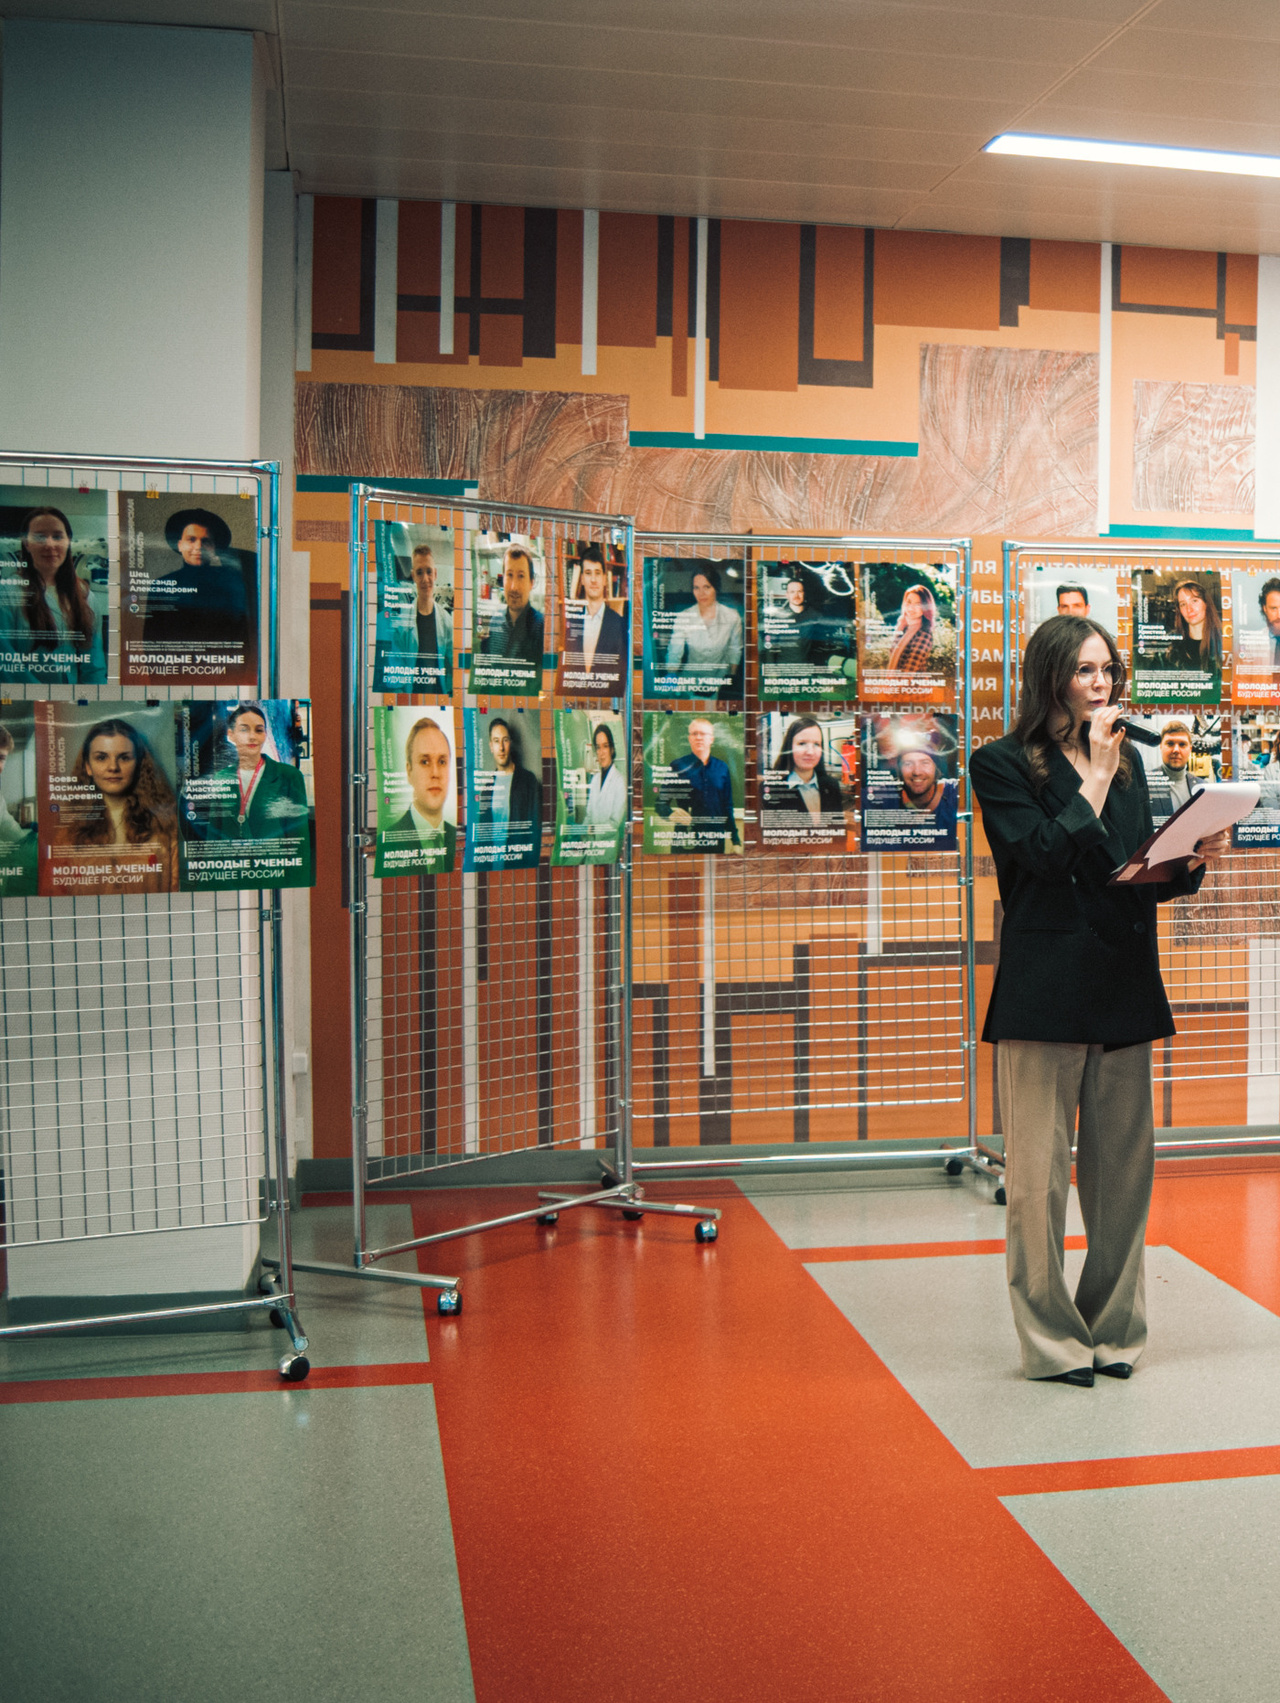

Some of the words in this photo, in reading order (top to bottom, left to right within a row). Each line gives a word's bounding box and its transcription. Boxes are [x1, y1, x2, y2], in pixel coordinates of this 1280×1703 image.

[129, 570, 149, 581] Шец
[129, 578, 177, 588] Александр
[129, 586, 198, 595] Александрович
[43, 654, 91, 665] УЧЕНЫЕ
[129, 654, 193, 667] МОЛОДЫЕ
[196, 655, 245, 666] УЧЕНЫЕ
[28, 664, 71, 675] РОССИИ
[129, 665, 179, 677] БУДУЩЕЕ
[182, 666, 226, 676] РОССИИ
[383, 666, 419, 676] МОЛОДЫЕ
[421, 667, 446, 677] УЧЕНЫЕ
[383, 676, 413, 684] БУДУЩЕЕ
[413, 677, 437, 685] РОССИИ
[654, 677, 697, 687] МОЛОДЫЕ
[698, 678, 733, 687] УЧЕНЫЕ
[764, 678, 808, 687] МОЛОДЫЕ
[810, 678, 847, 687] УЧЕНЫЕ
[864, 678, 907, 687] МОЛОДЫЕ
[908, 679, 946, 687] УЧЕНЫЕ
[654, 685, 687, 694] БУДУЩЕЕ
[688, 685, 719, 694] РОССИИ
[764, 686, 798, 694] БУДУЩЕЕ
[799, 686, 834, 694] РОССИИ
[864, 687, 900, 695] БУДУЩЕЕ
[901, 687, 933, 695] РОССИИ
[1137, 682, 1177, 690] МОЛОДЫЕ
[1178, 682, 1213, 691] УЧЕНЫЕ
[1238, 683, 1277, 691] МОЛОДЫЕ
[1137, 690, 1169, 699] БУДУЩЕЕ
[1171, 690, 1201, 698] РОССИИ
[1237, 690, 1269, 699] БУДУЩЕЕ
[48, 774, 78, 784] Боева
[184, 778, 241, 788] Никифорова
[49, 783, 96, 792] Василиса
[185, 786, 231, 794] Анастасия
[50, 792, 103, 802] Андреевна
[185, 793, 238, 802] Алексеевна
[763, 829, 808, 837] МОЛОДЫЕ
[810, 829, 846, 837] УЧЕНЫЕ
[867, 829, 911, 837] МОЛОДЫЕ
[912, 829, 948, 837] УЧЕНЫЕ
[1238, 825, 1278, 834] МОЛОДЫЕ
[653, 831, 696, 840] МОЛОДЫЕ
[698, 831, 732, 840] УЧЕНЫЕ
[1238, 834, 1270, 842] БУДУЩЕЕ
[653, 839, 688, 847] БУДУЩЕЕ
[763, 837, 799, 845] БУДУЩЕЕ
[801, 837, 833, 845] РОССИИ
[867, 837, 902, 845] БУДУЩЕЕ
[903, 837, 935, 845] РОССИИ
[474, 845, 507, 854] МОЛОДЫЕ
[507, 843, 534, 852] УЧЕНЫЕ
[384, 850, 419, 860] МОЛОДЫЕ
[420, 847, 448, 857] УЧЕНЫЕ
[473, 854, 499, 863] БУДУЩЕЕ
[499, 852, 524, 861] РОССИИ
[188, 858, 251, 871] МОЛОДЫЕ
[254, 856, 303, 868] УЧЕНЫЕ
[383, 859, 411, 869] БУДУЩЕЕ
[411, 857, 437, 867] РОССИИ
[53, 865, 112, 877] МОЛОДЫЕ
[116, 863, 163, 875] УЧЕНЫЕ
[188, 869, 238, 882] БУДУЩЕЕ
[241, 867, 285, 879] РОССИИ
[53, 876, 99, 887] БУДУЩЕЕ
[102, 875, 144, 885] РОССИИ
